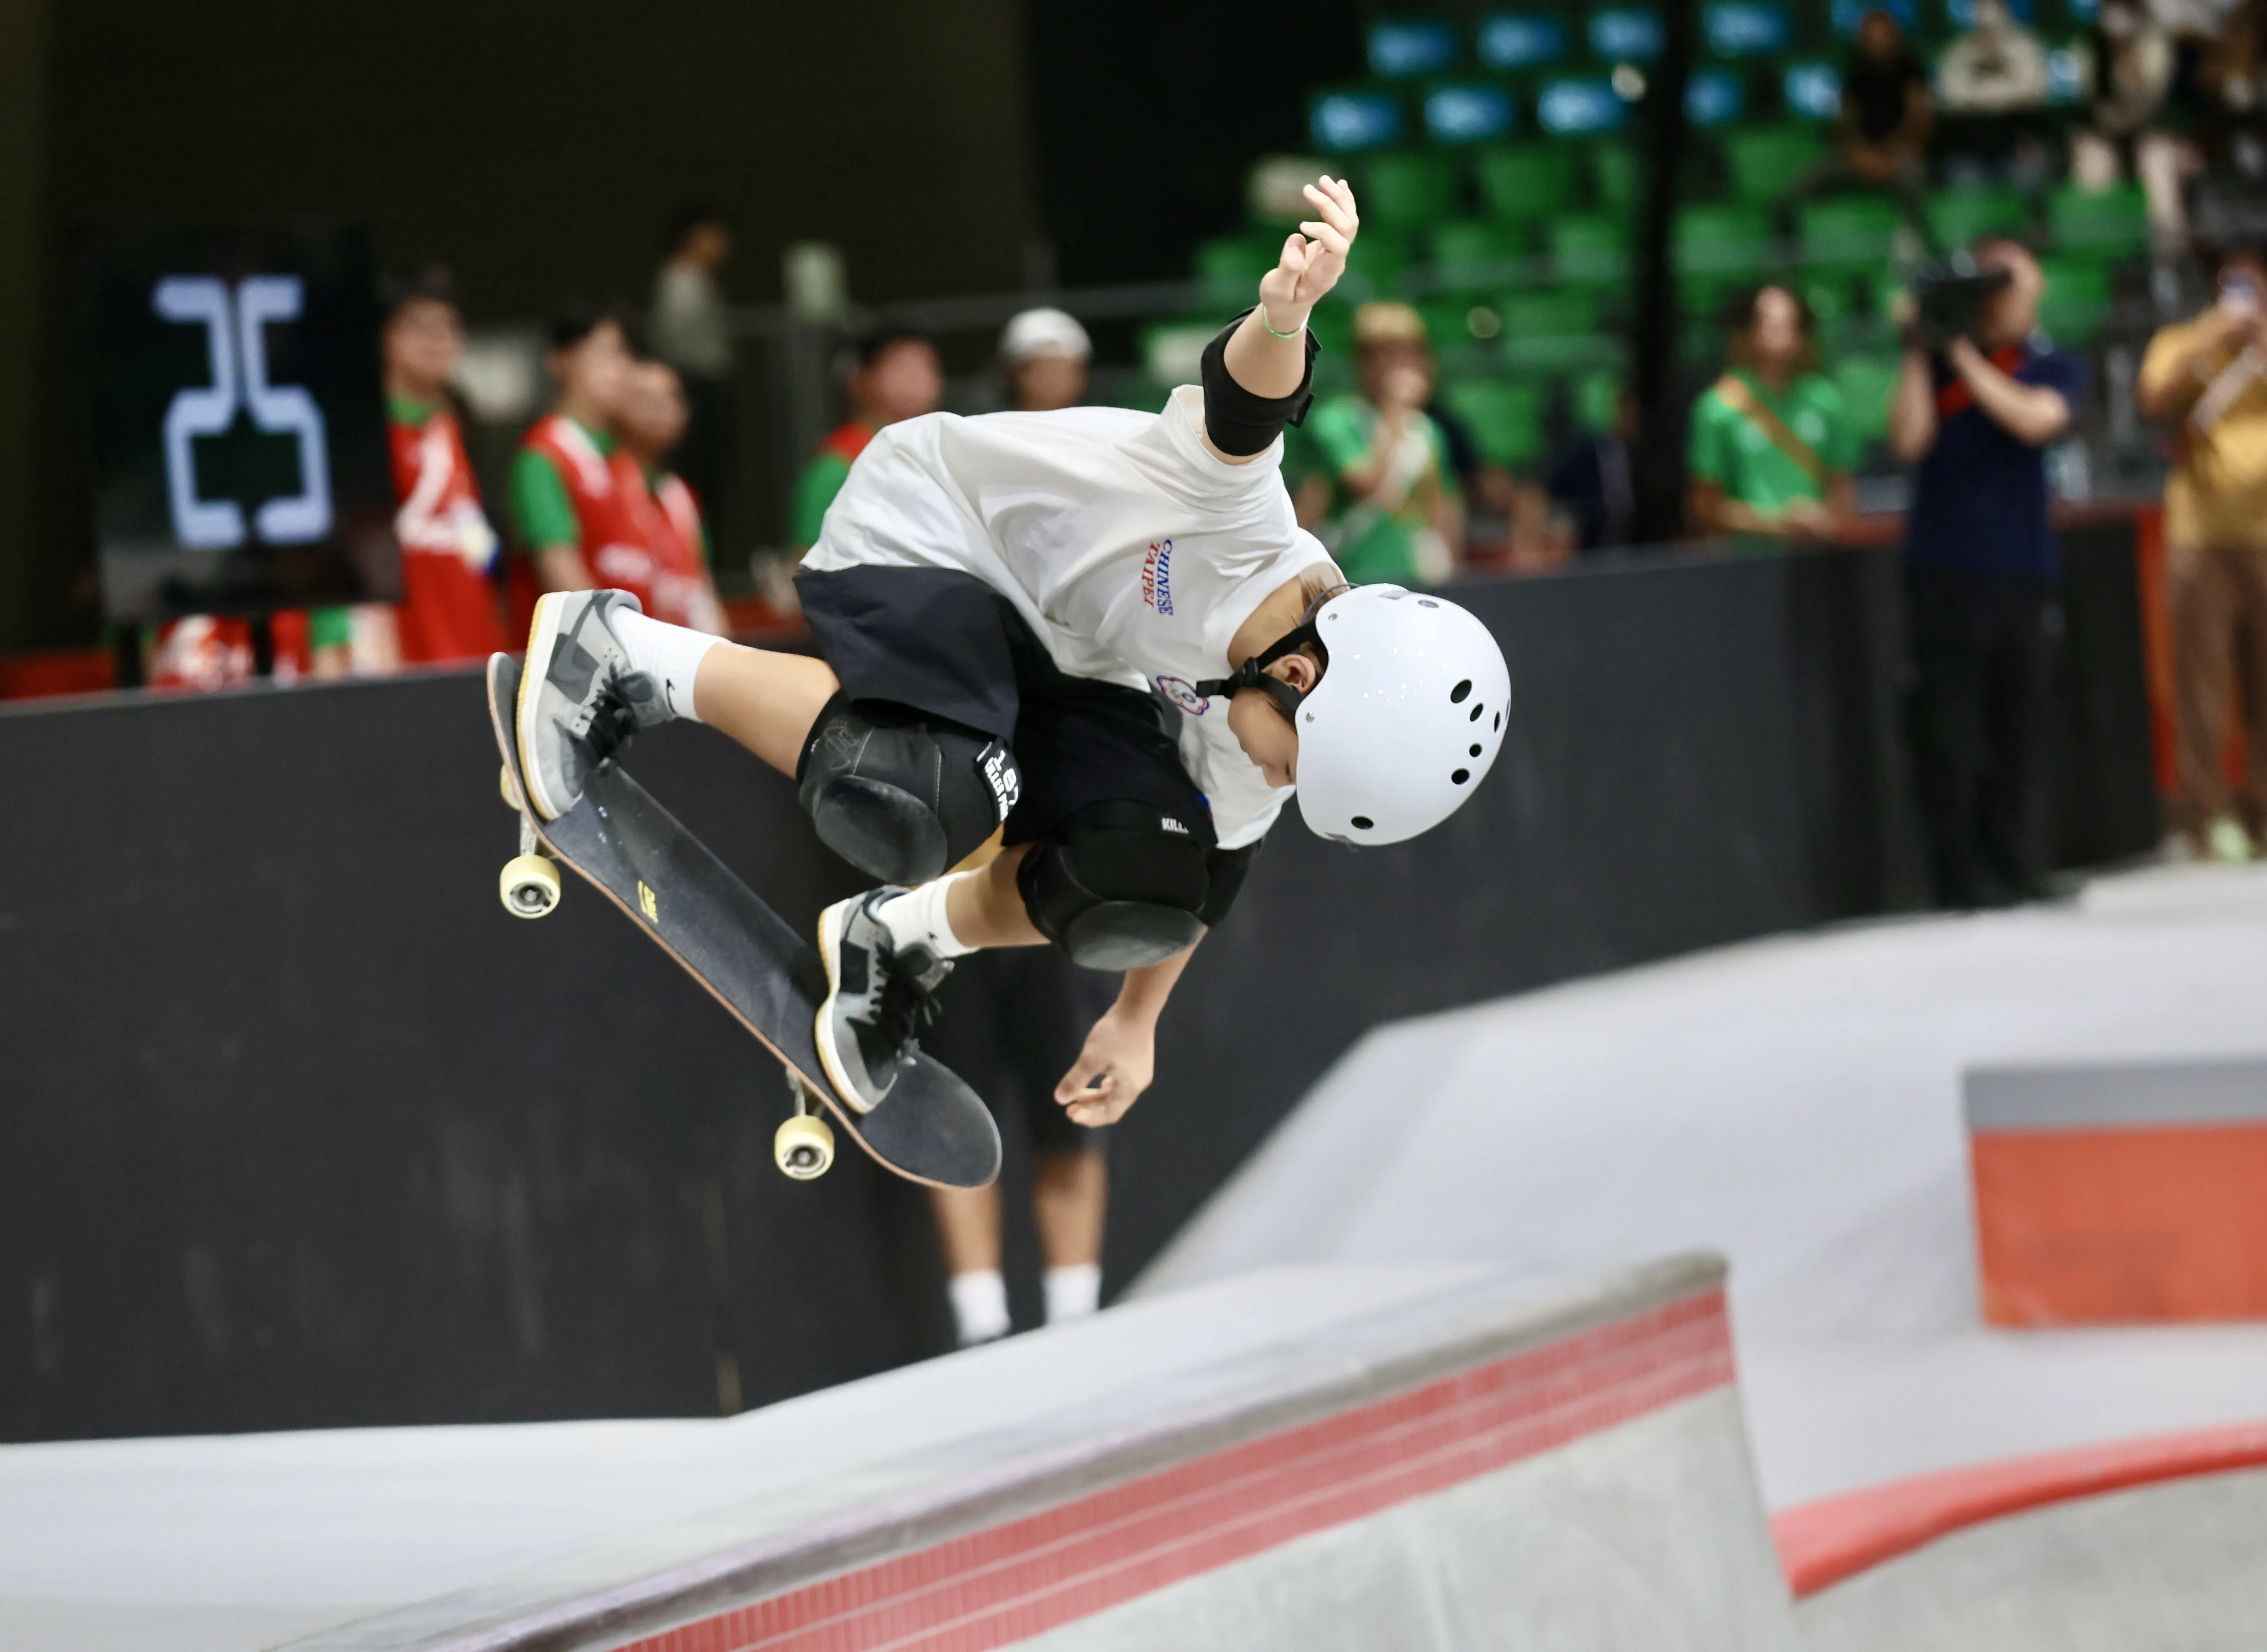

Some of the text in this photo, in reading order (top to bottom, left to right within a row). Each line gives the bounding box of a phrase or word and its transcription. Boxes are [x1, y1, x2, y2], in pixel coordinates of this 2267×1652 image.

[1142, 542, 1160, 608] TAIPEI
[1157, 539, 1173, 615] CHINESE
[993, 750, 1018, 805] 187
[1161, 817, 1190, 834] KILL
